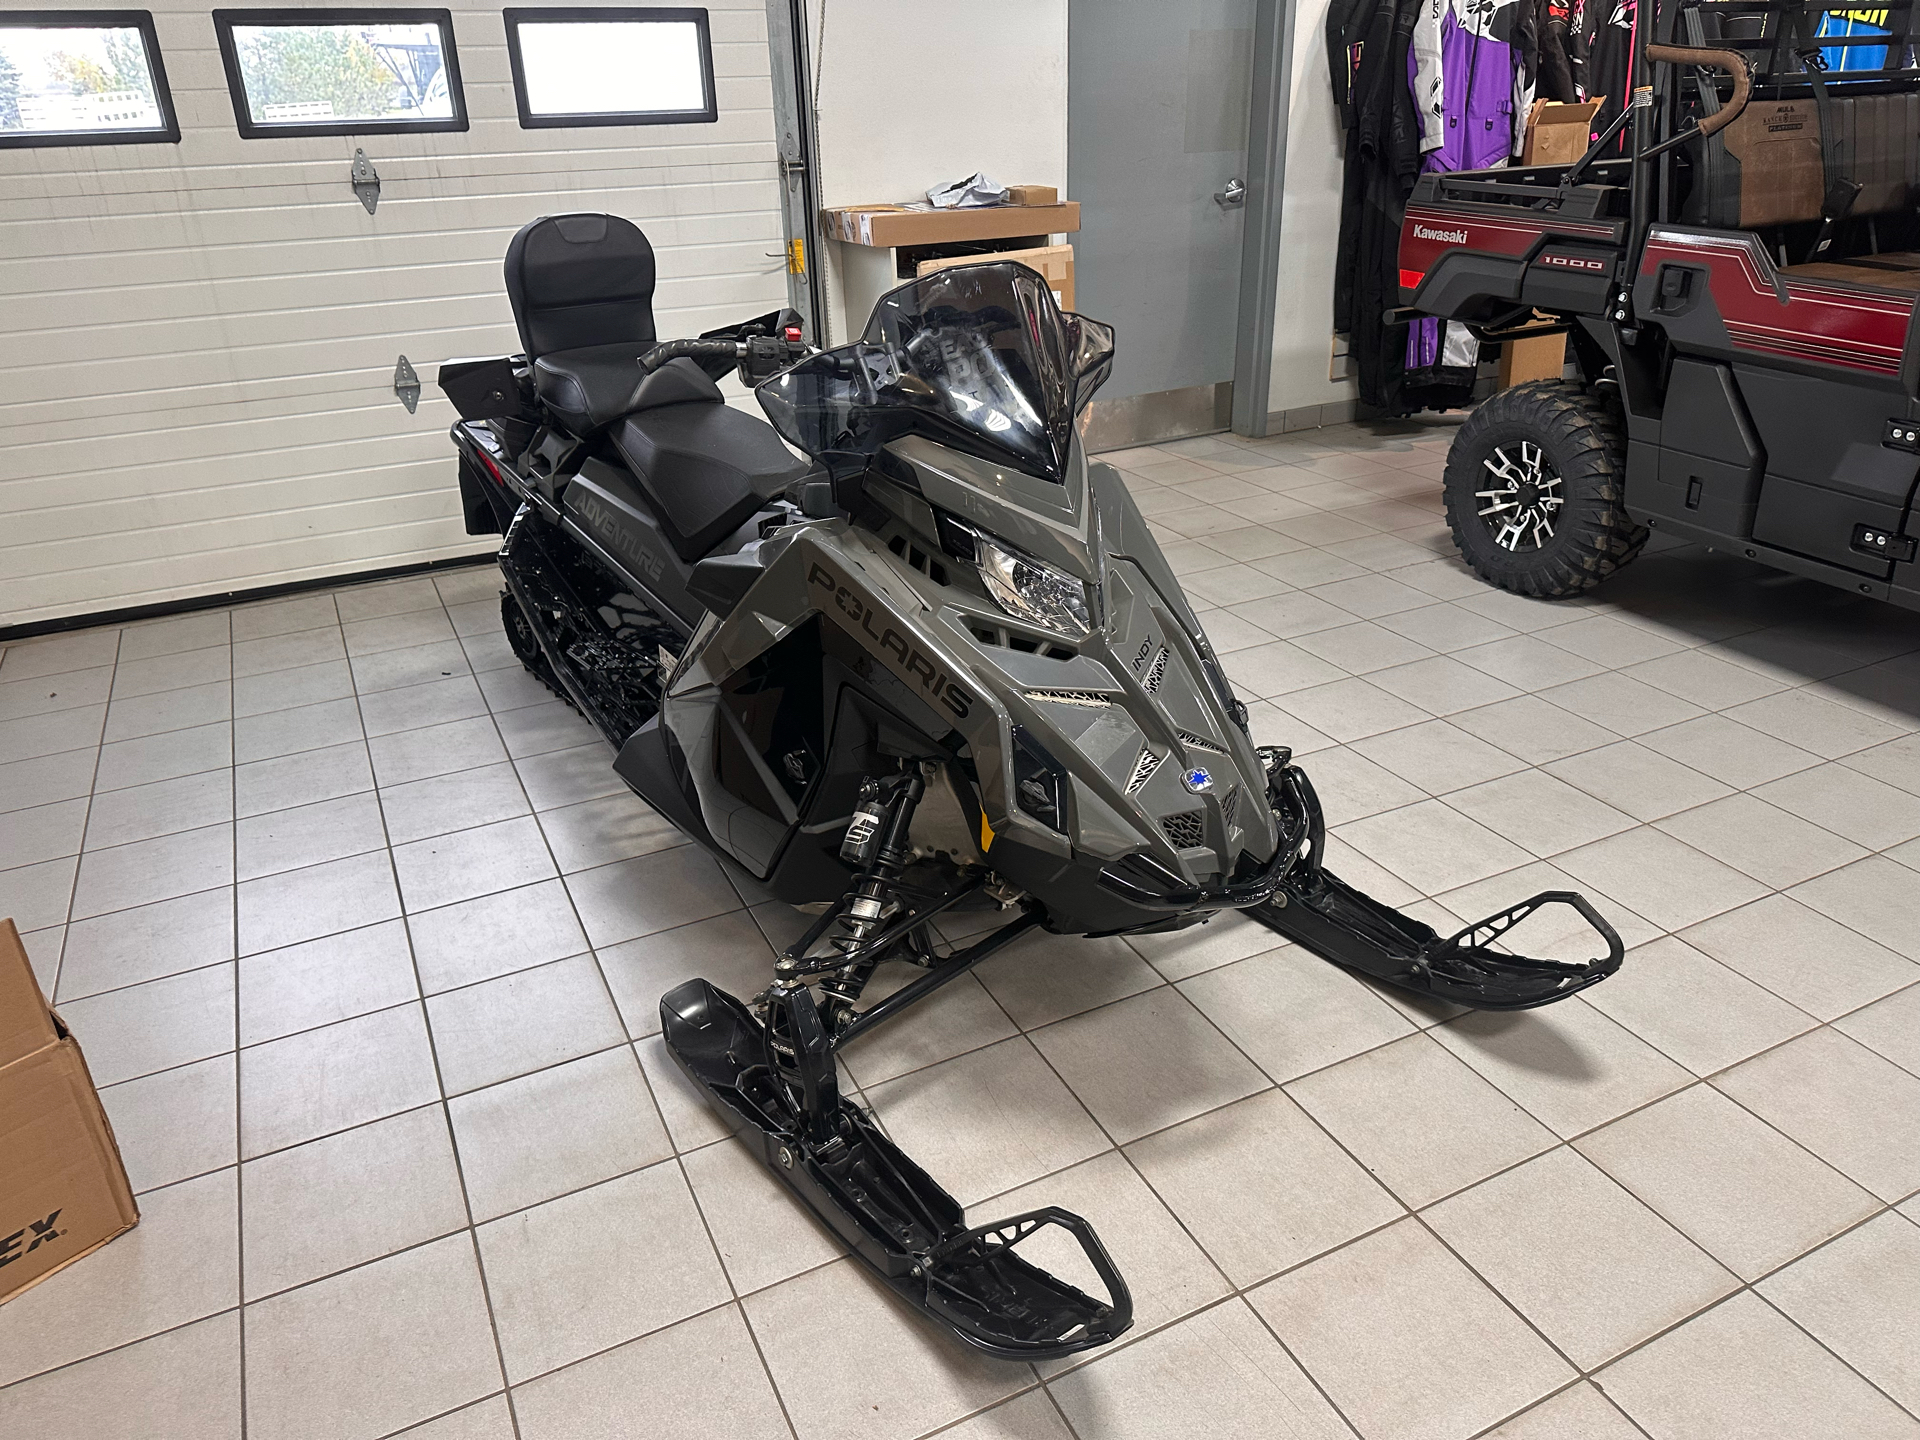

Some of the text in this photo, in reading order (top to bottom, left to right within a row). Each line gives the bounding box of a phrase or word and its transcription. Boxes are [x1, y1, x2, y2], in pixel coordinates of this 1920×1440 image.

[1413, 224, 1468, 244] Kawasaki
[1545, 256, 1603, 269] 1000
[574, 488, 666, 582] ADVENTURE
[807, 562, 974, 719] POLARIS
[1132, 634, 1153, 672] INDY
